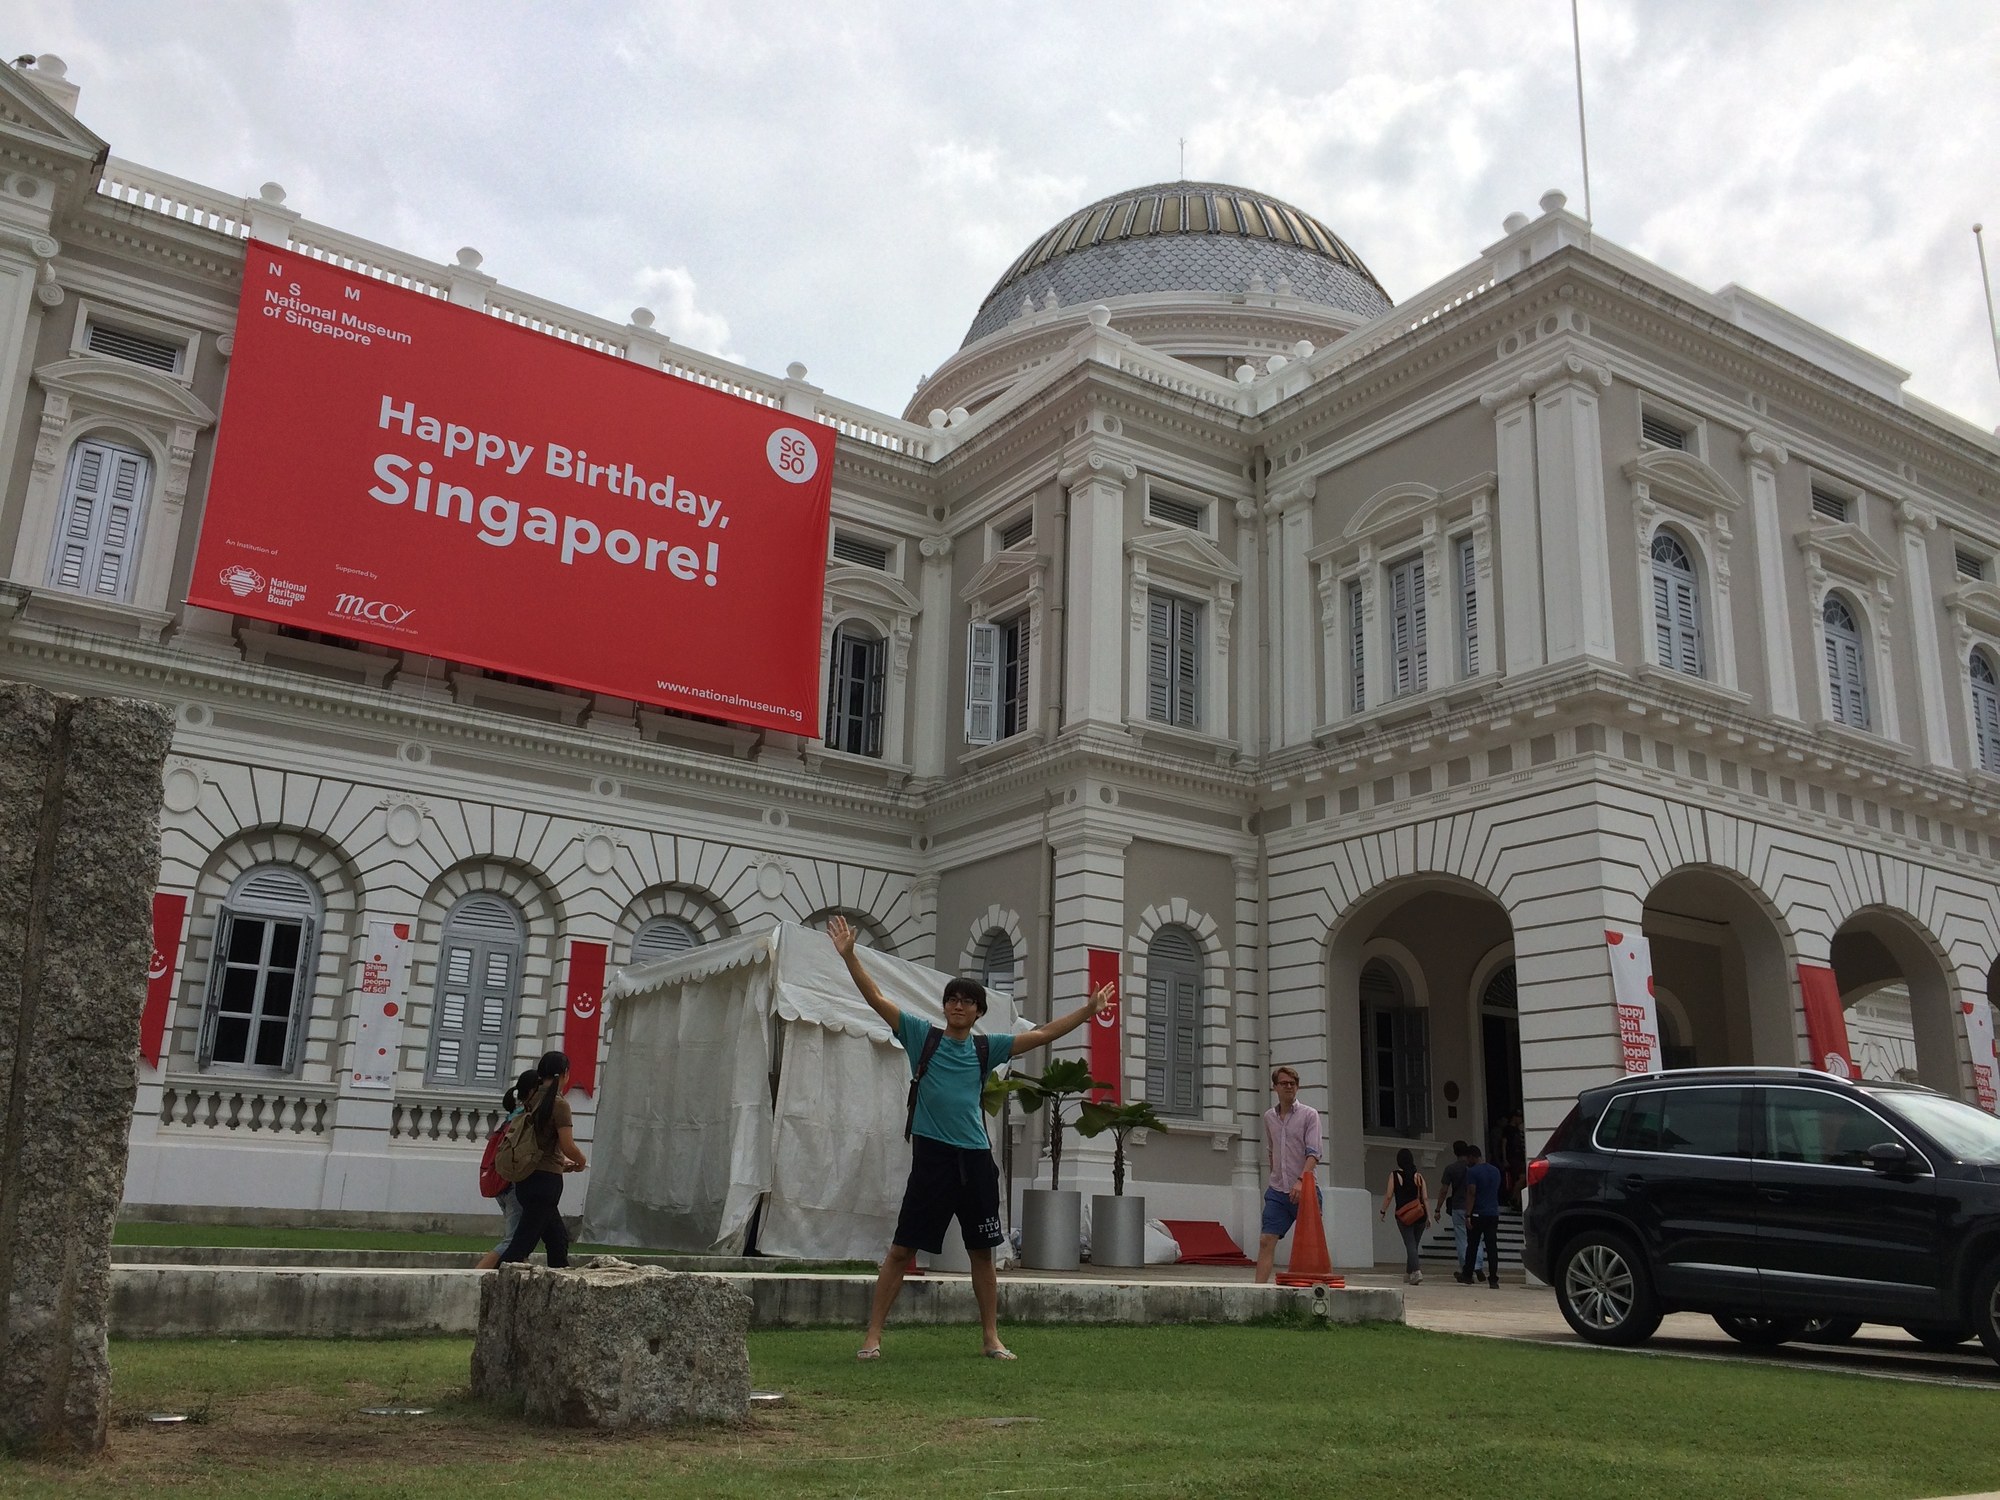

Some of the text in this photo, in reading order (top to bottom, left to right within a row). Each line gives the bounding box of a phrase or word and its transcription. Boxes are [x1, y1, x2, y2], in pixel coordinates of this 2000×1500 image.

[268, 262, 283, 277] N
[288, 282, 301, 296] S
[344, 286, 361, 302] M
[264, 289, 412, 345] National Museum
[263, 306, 372, 346] of Singapore
[779, 435, 806, 457] SG
[378, 394, 730, 530] Happy Birthday,
[778, 452, 805, 475] 50
[367, 453, 720, 588] Singapore!
[225, 538, 236, 546] An
[236, 541, 270, 554] Institution
[335, 563, 378, 581] Supported by
[270, 577, 307, 593] National
[267, 594, 293, 607] Board
[269, 585, 306, 602] Heritage
[657, 679, 803, 722] www.nationalmuseum.sg
[364, 971, 377, 979] on,
[365, 963, 387, 971] Shine
[362, 985, 372, 993] of
[363, 978, 390, 987] people
